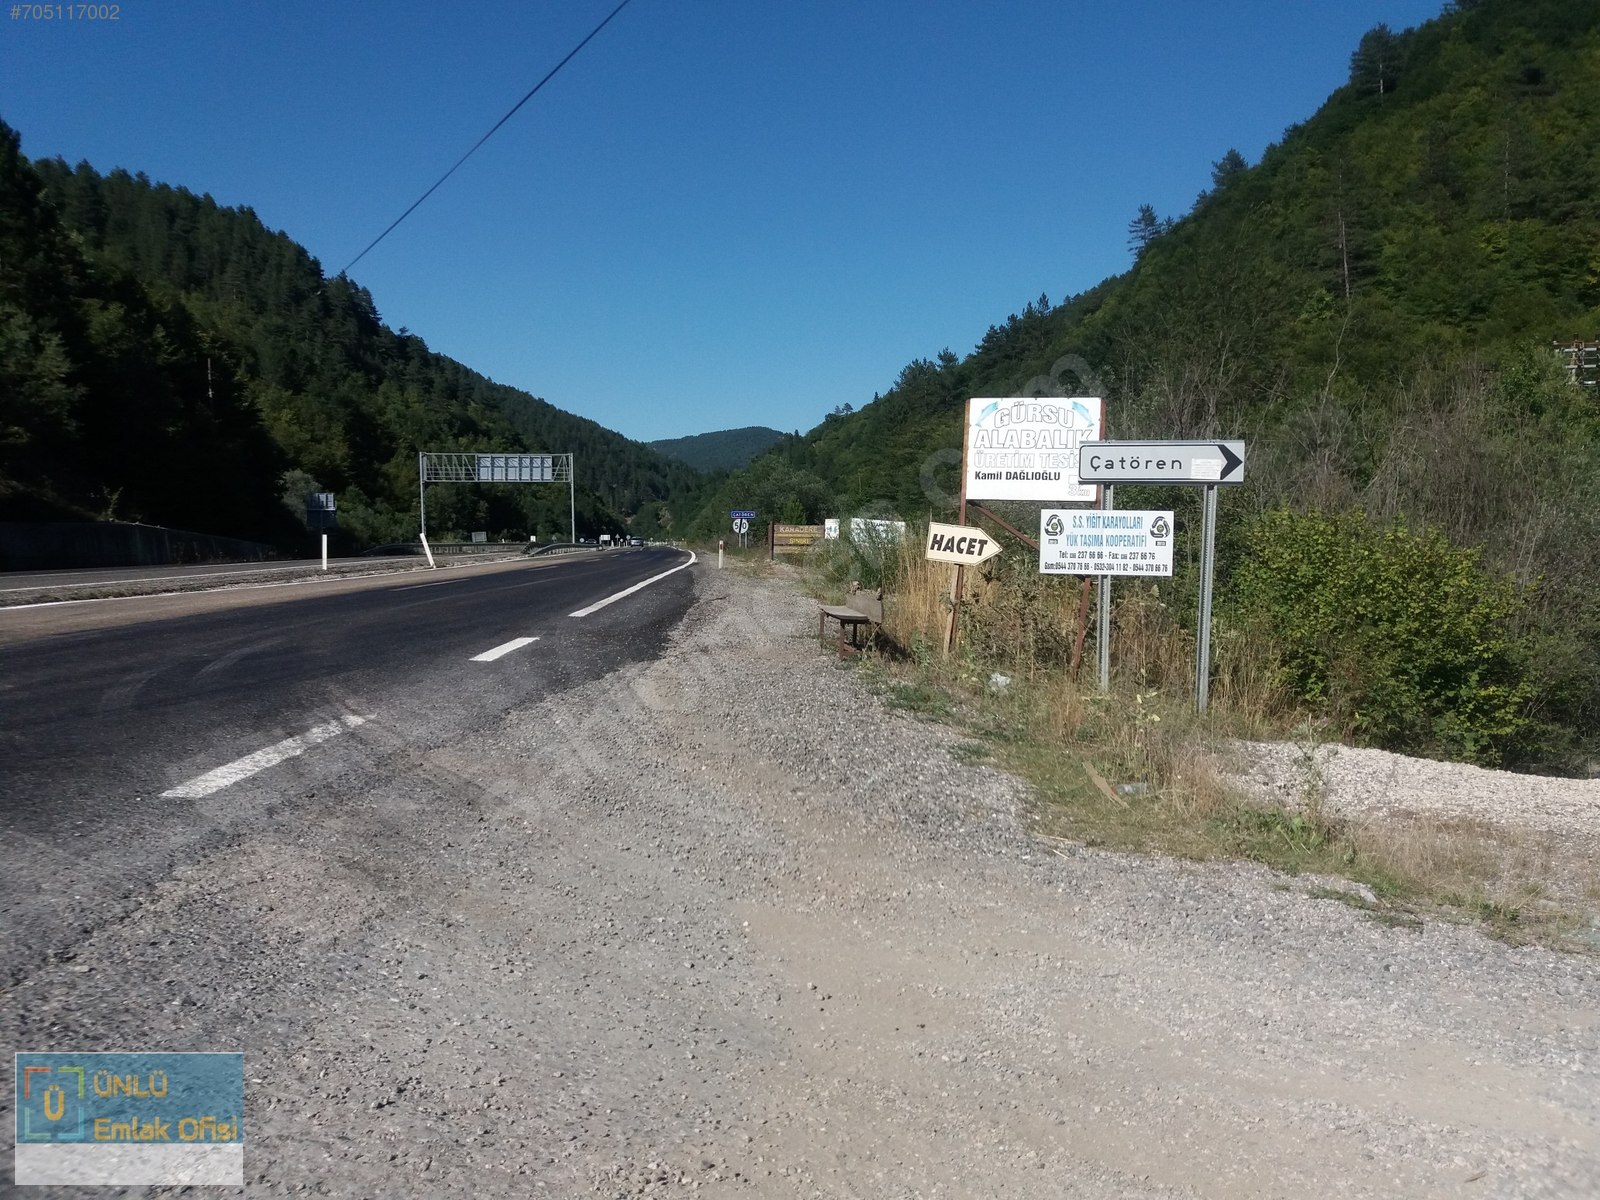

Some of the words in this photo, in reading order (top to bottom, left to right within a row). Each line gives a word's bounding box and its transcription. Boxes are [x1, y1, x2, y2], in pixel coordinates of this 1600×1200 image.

[994, 401, 1074, 428] GÜRSU
[974, 450, 1035, 468] ÜRETİM
[1090, 456, 1182, 471] Çatören
[975, 471, 1002, 480] Kamil
[1005, 470, 1060, 480] DAĞLIOĞLU
[1072, 515, 1084, 529] S.S.
[1086, 513, 1101, 529] YİĞİT
[1102, 516, 1143, 530] KARAYOLLARI
[930, 533, 988, 556] HACET
[1066, 532, 1078, 547] YÜK
[1080, 534, 1104, 548] TAŞIMA
[1078, 551, 1087, 559] 237
[1129, 552, 1139, 560] 237
